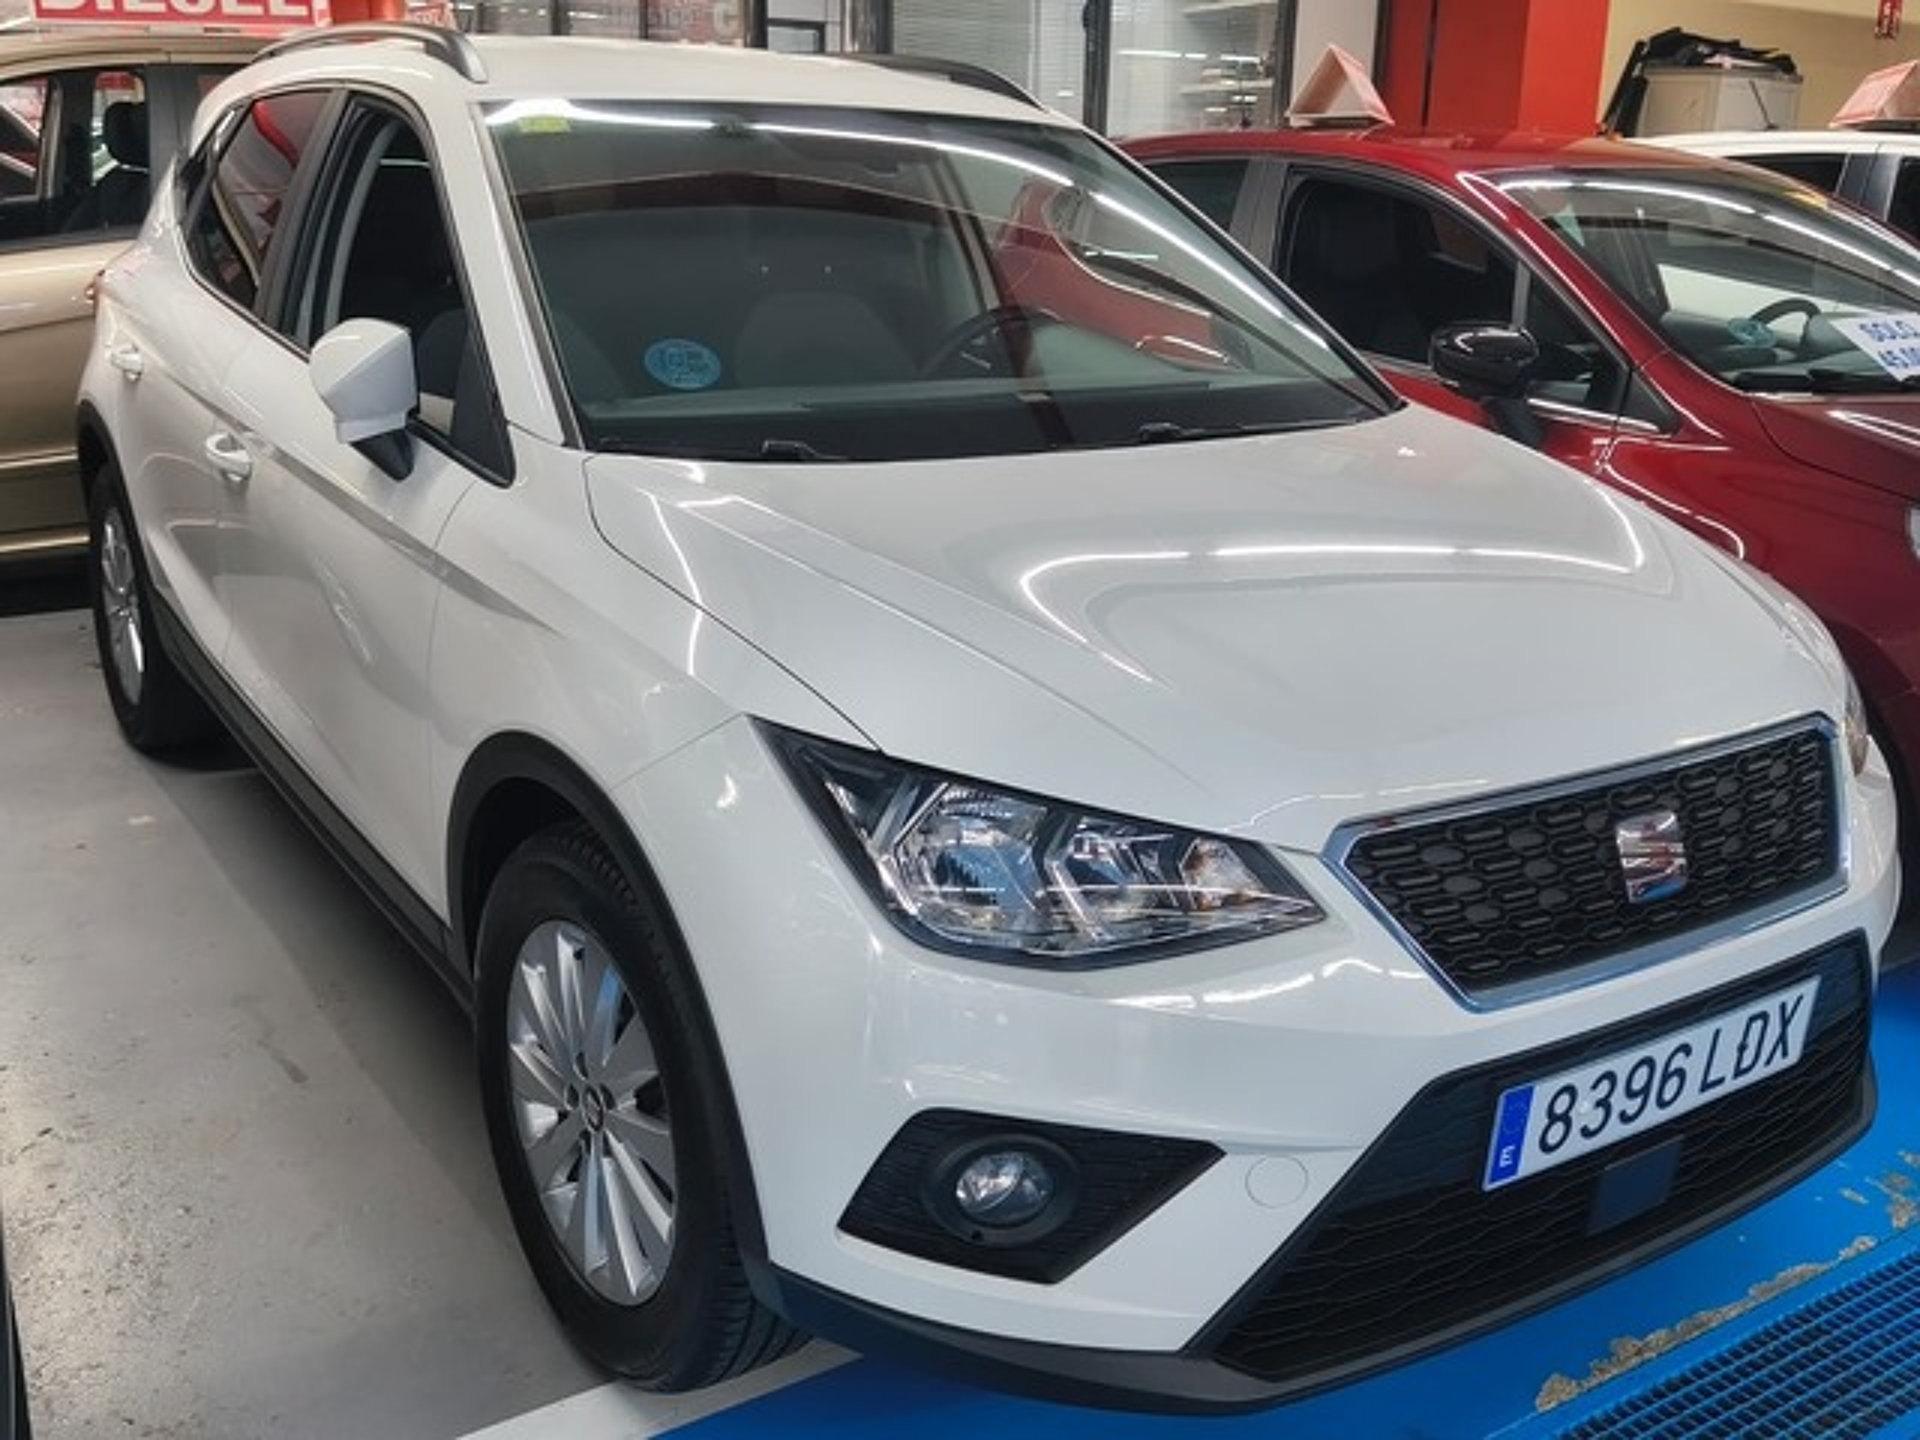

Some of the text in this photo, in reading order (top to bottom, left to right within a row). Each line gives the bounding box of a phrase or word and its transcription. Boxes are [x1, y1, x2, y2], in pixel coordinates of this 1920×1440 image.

[1538, 993, 1806, 1155] 8396 LDX
[1499, 1145, 1517, 1168] E
